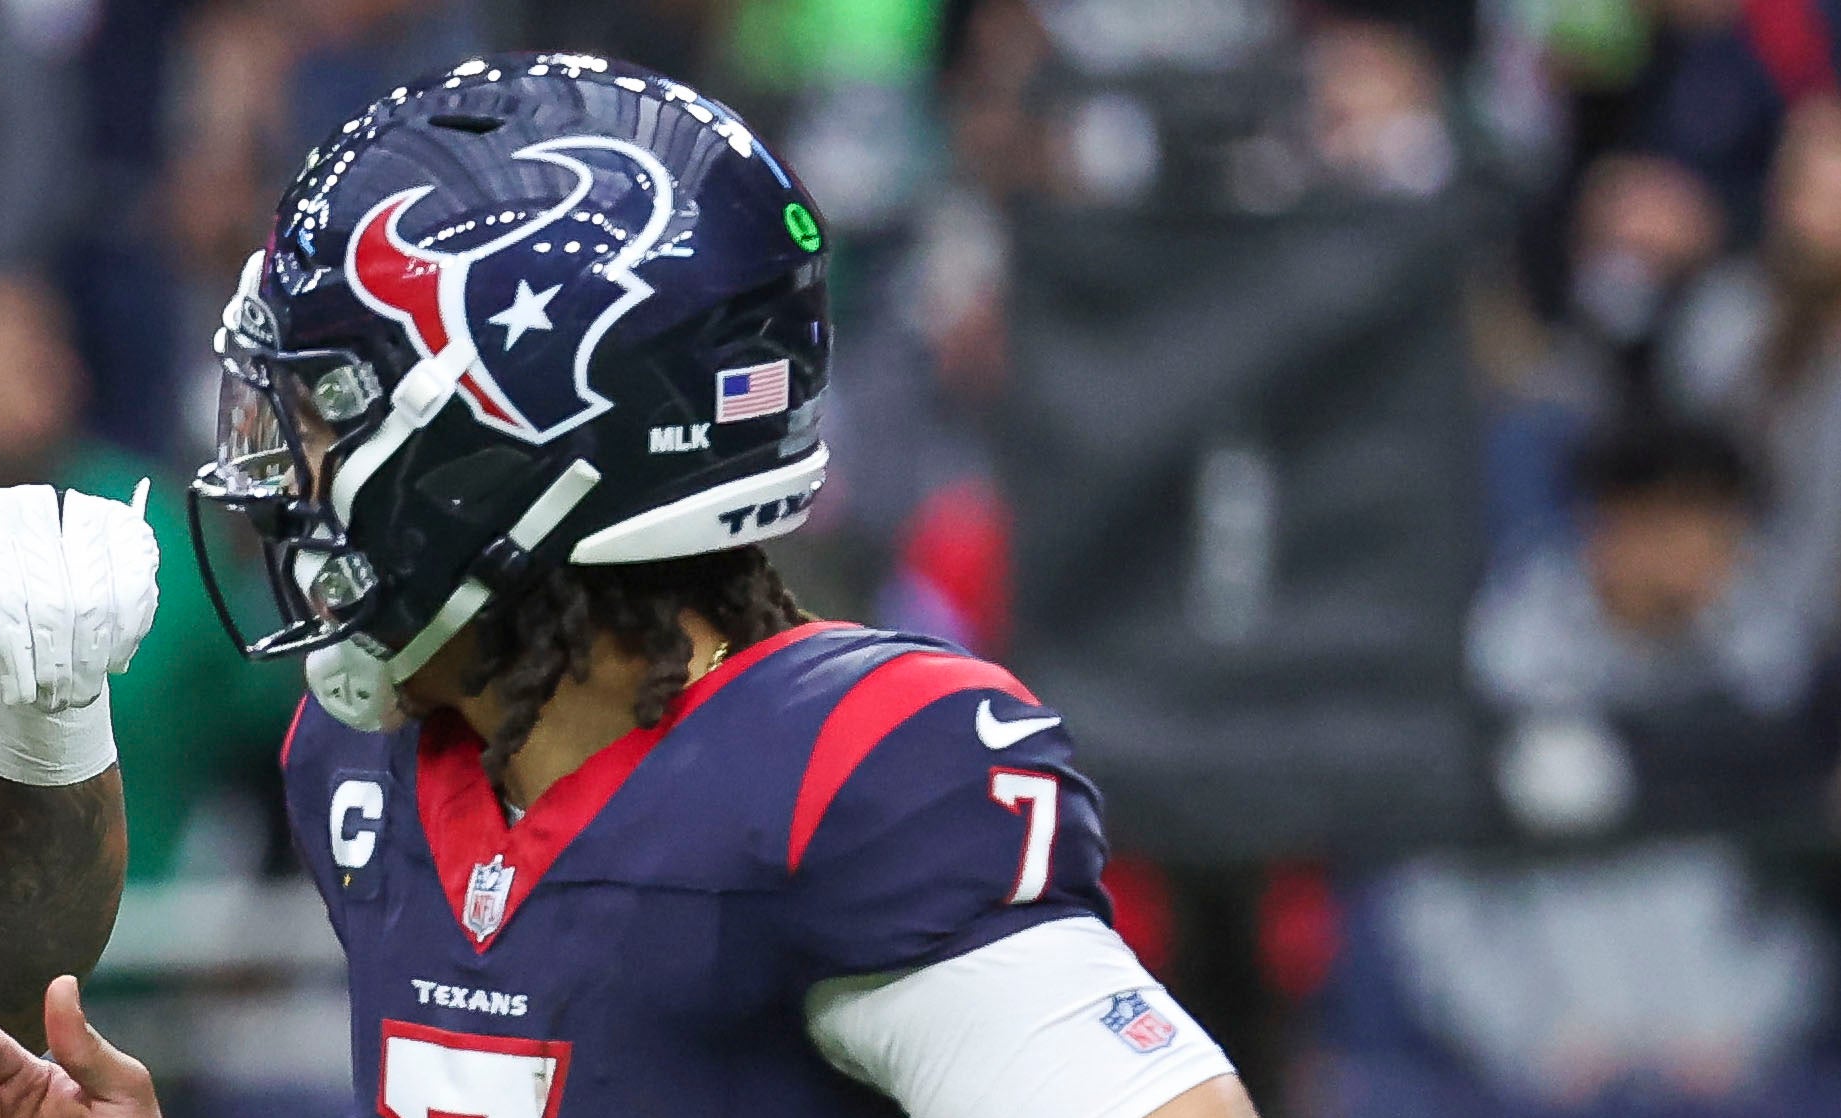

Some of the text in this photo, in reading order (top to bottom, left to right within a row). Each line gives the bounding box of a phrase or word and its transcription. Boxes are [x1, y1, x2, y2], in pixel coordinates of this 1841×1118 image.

[648, 422, 711, 453] MLK
[330, 780, 383, 868] C
[988, 765, 1061, 905] 7
[411, 979, 528, 1016] TEXANS
